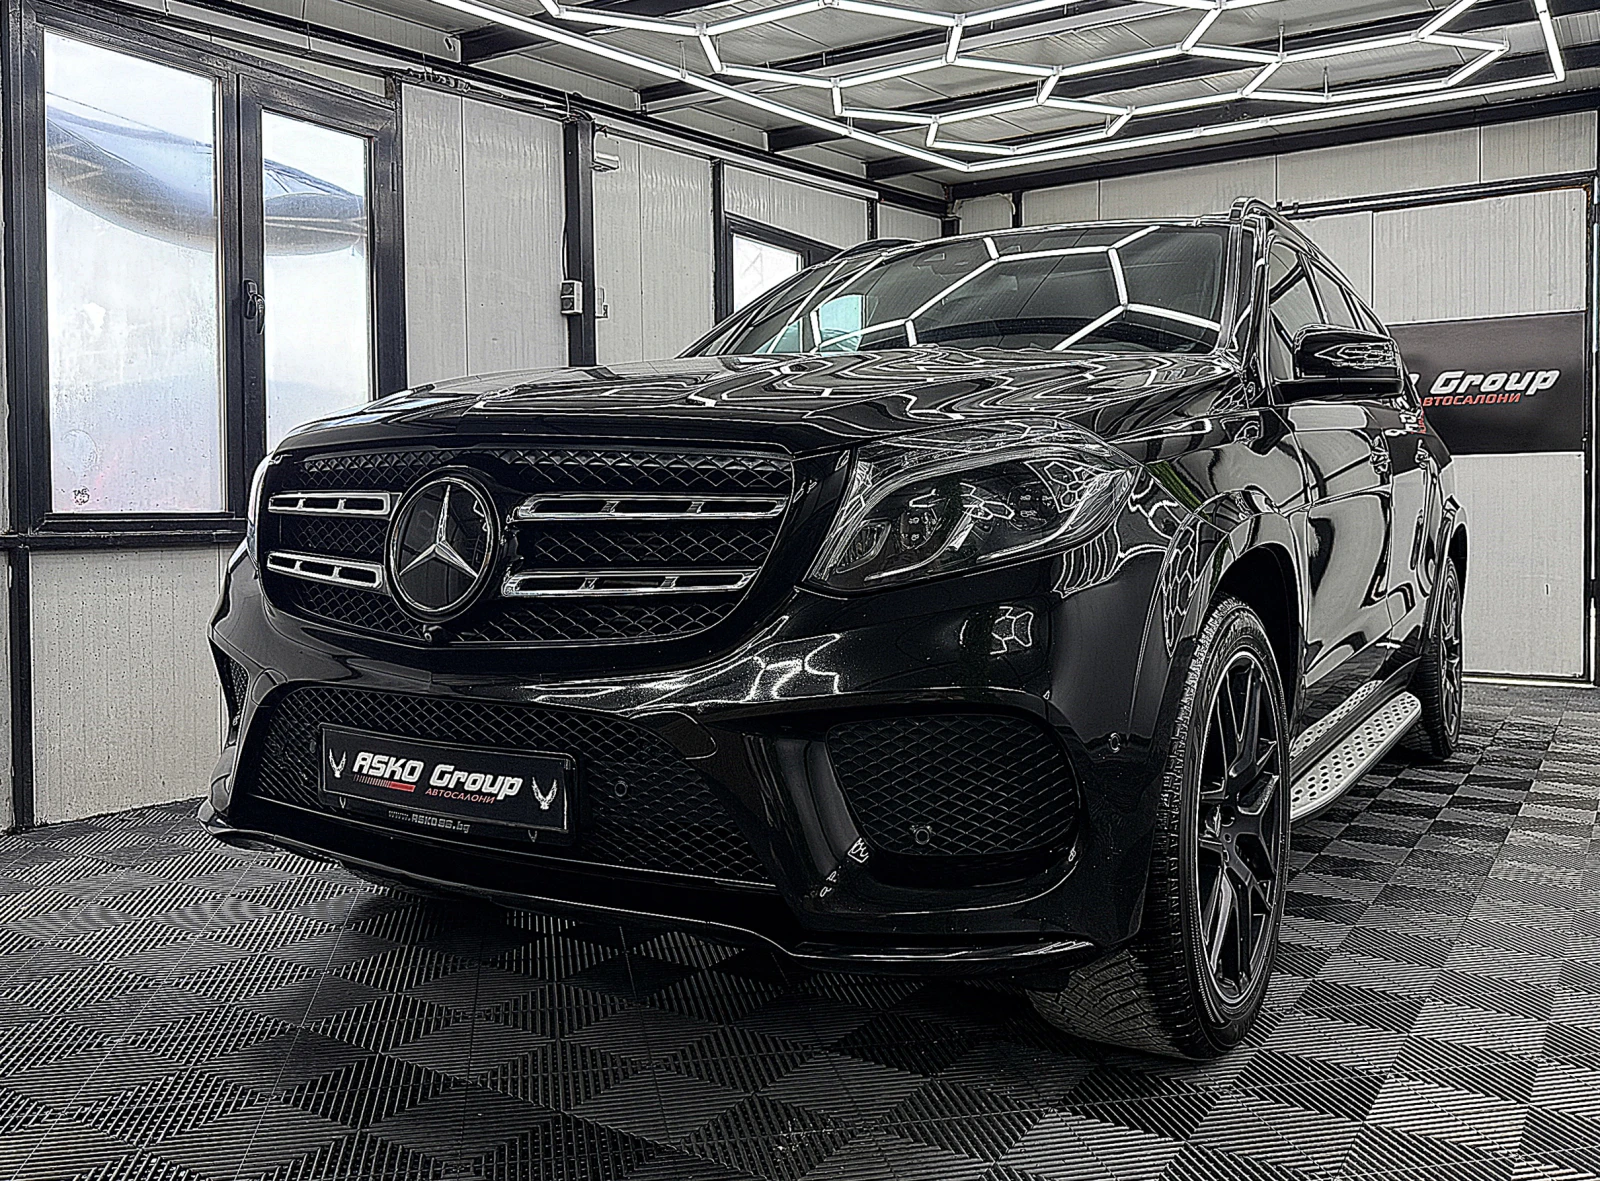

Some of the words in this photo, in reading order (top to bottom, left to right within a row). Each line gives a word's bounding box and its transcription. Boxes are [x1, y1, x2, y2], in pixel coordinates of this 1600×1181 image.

[1430, 370, 1560, 395] Group
[1419, 393, 1521, 407] ВТОСАЛОНИ
[352, 752, 424, 782] ASKO
[429, 764, 523, 800] Group
[425, 788, 496, 804] АВТОСАЛОНИ
